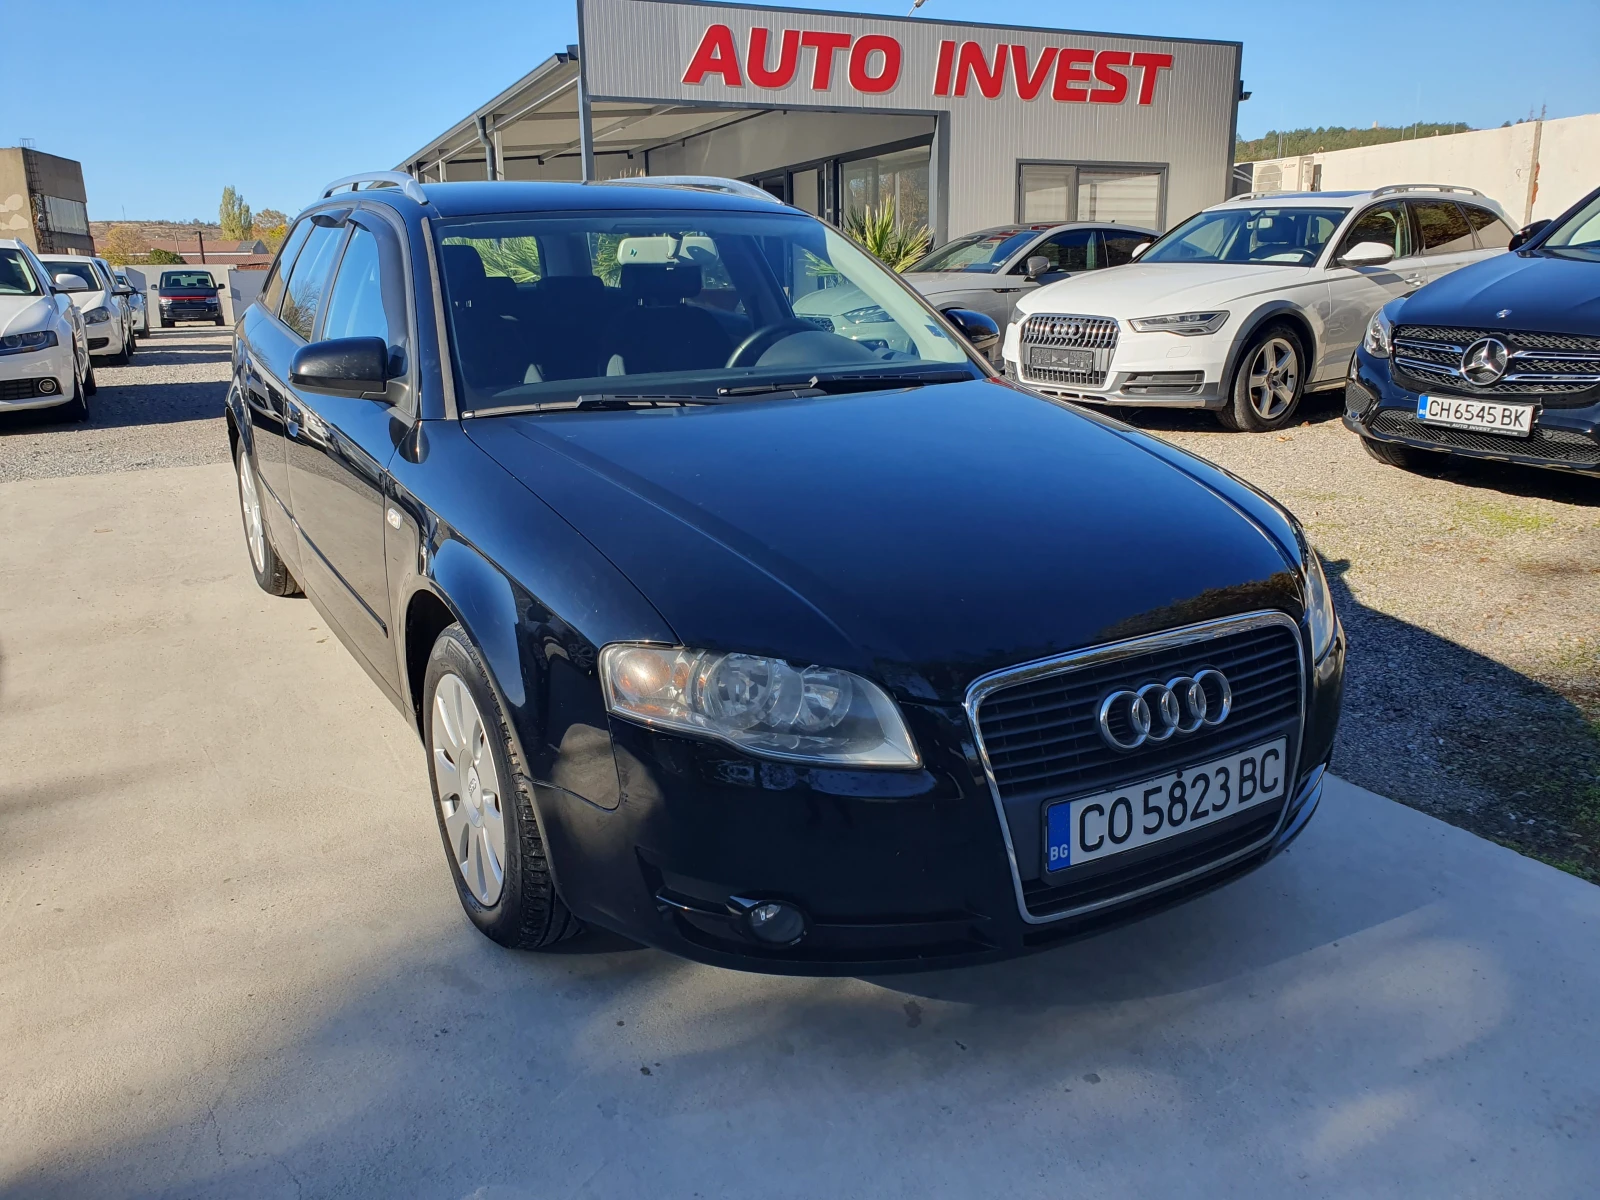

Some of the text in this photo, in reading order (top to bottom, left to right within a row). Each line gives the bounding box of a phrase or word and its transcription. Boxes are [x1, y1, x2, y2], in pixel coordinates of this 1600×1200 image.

[681, 24, 1173, 106] AUTO INVEST
[1429, 400, 1527, 428] CH 6545 BK
[1468, 424, 1492, 432] INVEST
[1078, 748, 1280, 853] CO 5823 BC
[1050, 843, 1069, 861] BG
